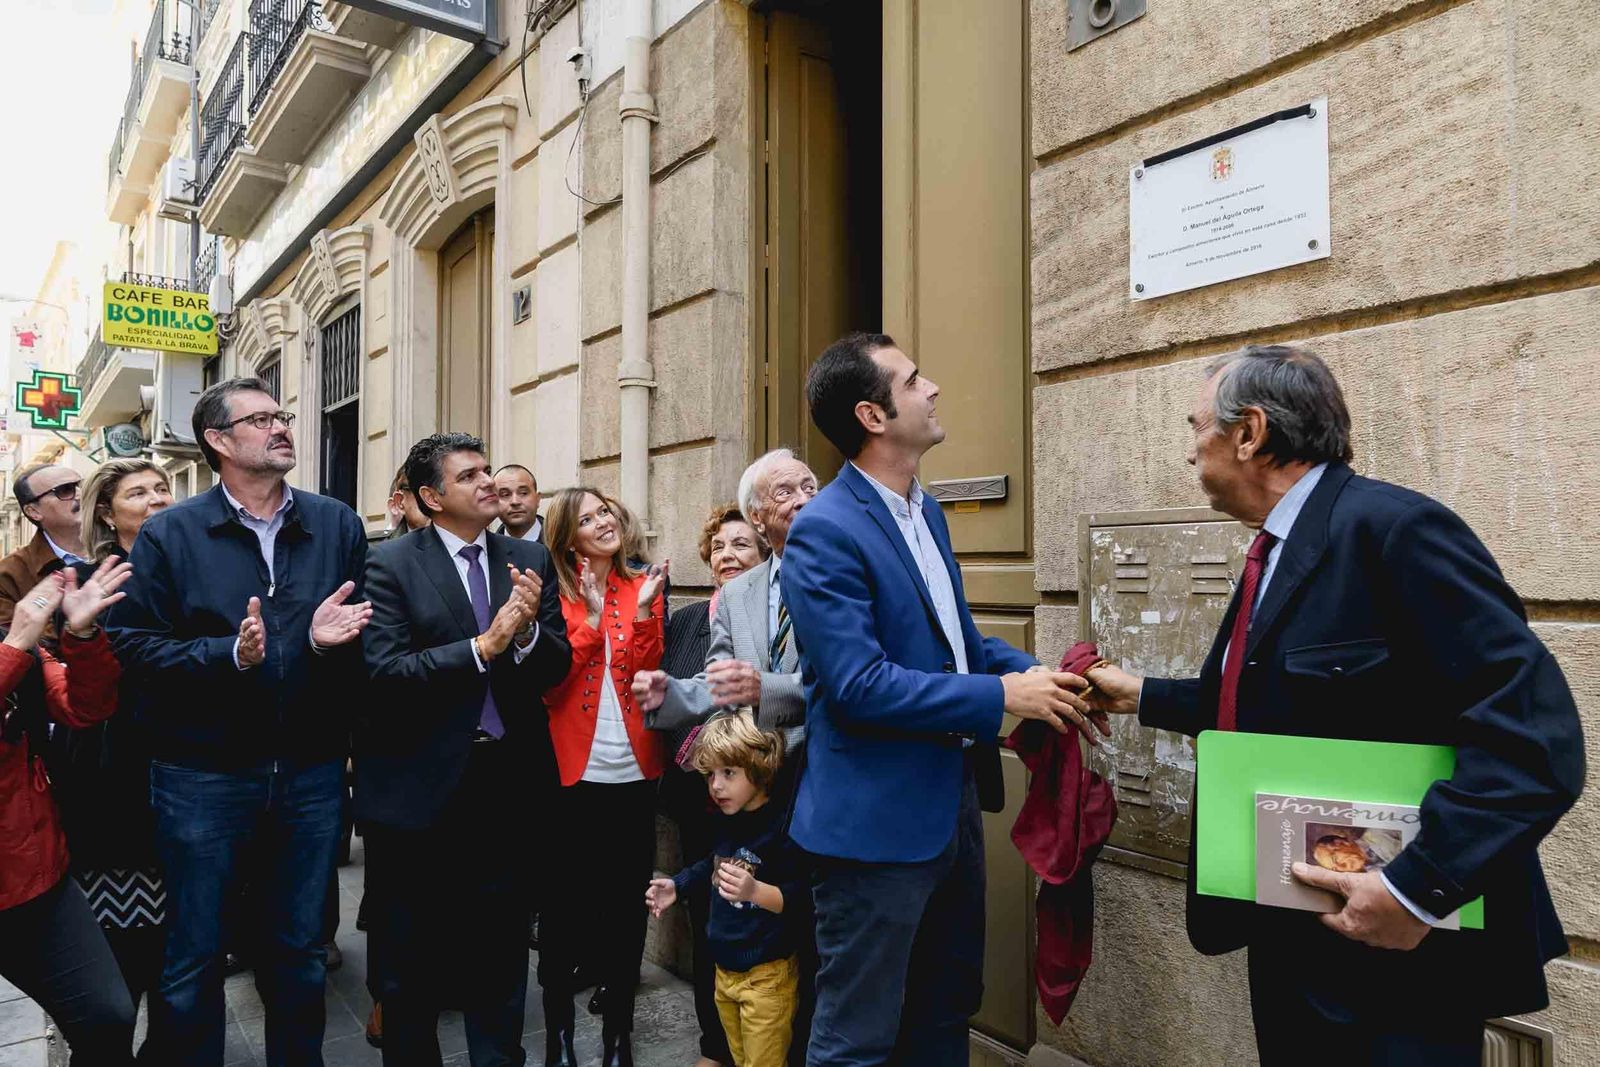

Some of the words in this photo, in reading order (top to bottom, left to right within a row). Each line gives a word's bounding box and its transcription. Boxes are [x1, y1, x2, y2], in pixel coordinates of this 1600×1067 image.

[1190, 219, 1211, 230] Manuel
[1212, 215, 1222, 224] del
[1243, 204, 1265, 215] Ortega
[112, 287, 163, 305] CAFE
[173, 295, 209, 311] BAR
[107, 303, 214, 332] BONILLO
[112, 333, 153, 345] PATATAS
[179, 341, 209, 351] BRAVA
[127, 327, 196, 341] ESPECIALIDAD
[1257, 797, 1420, 825] omenaje
[1279, 818, 1297, 886] Homenaje
